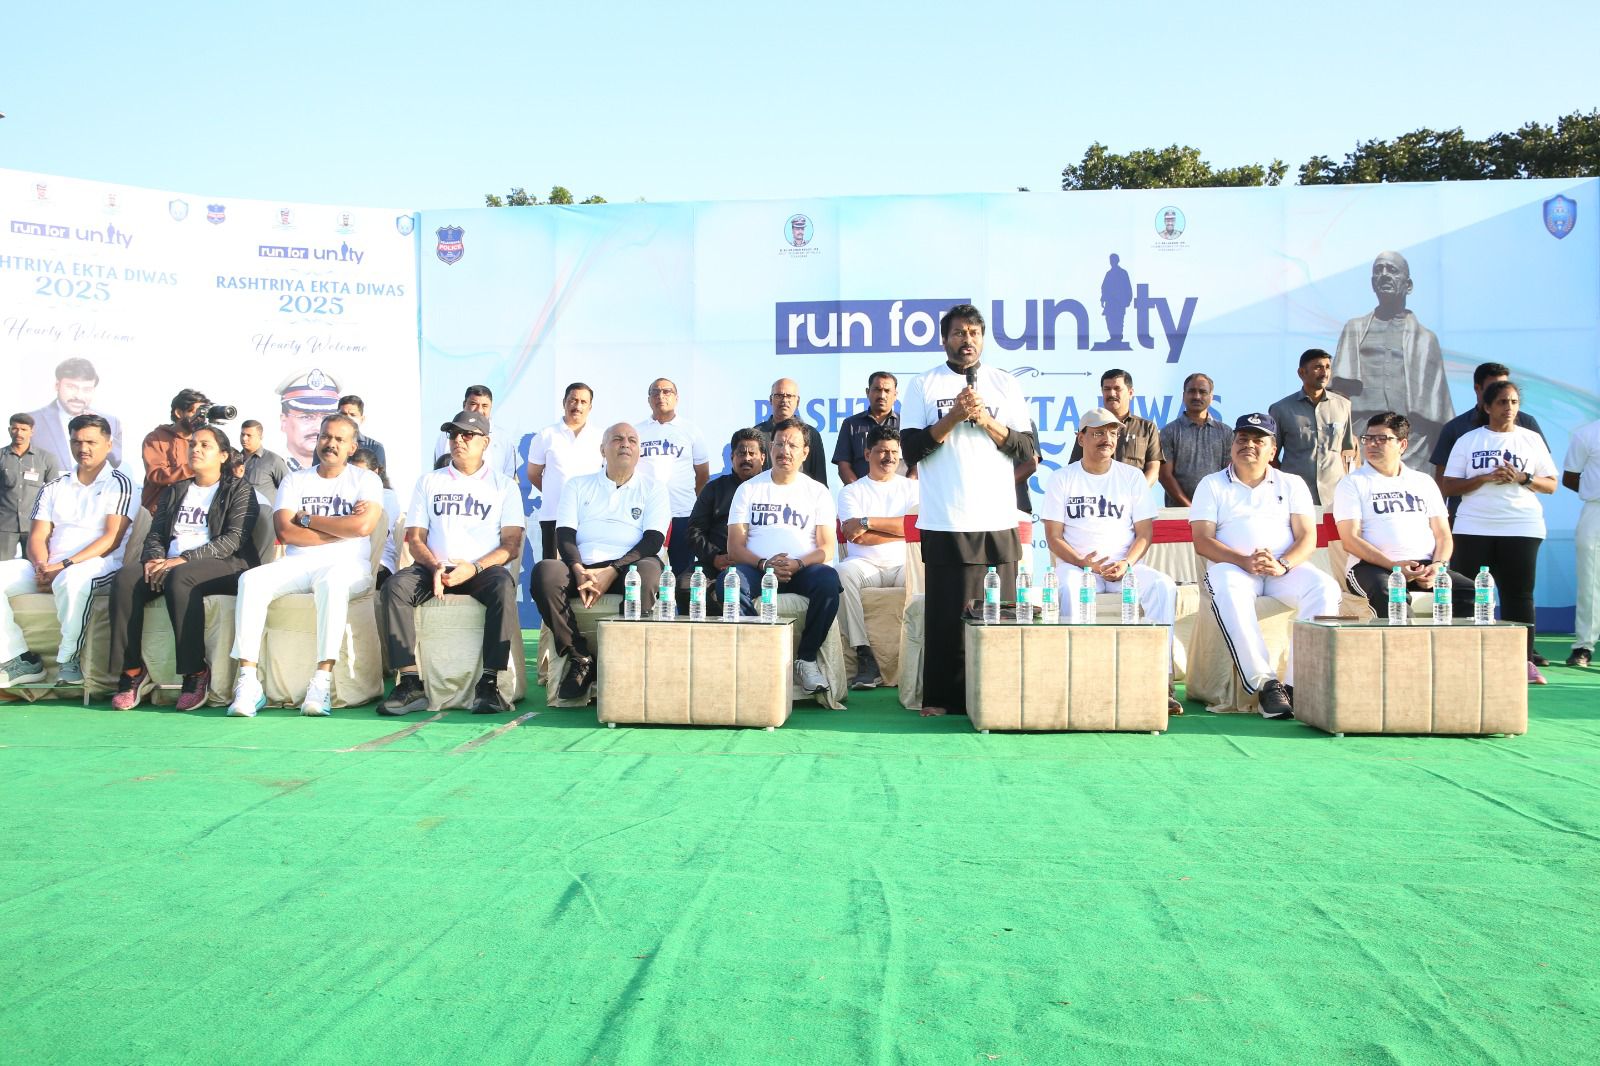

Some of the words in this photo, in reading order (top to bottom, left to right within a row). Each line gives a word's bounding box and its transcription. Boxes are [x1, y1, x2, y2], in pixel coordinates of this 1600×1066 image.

[13, 222, 42, 236] run
[45, 223, 67, 239] for
[76, 222, 133, 249] unity
[439, 243, 463, 251] POLICE
[260, 247, 285, 258] run
[286, 247, 306, 259] for
[313, 241, 364, 265] unity
[72, 262, 118, 280] EKTA
[124, 267, 178, 286] DIWAS
[216, 275, 305, 292] RASHTRIYA
[311, 280, 351, 295] EKTA
[356, 283, 405, 297] DIWAS
[35, 276, 111, 302] 2025
[278, 294, 344, 316] 2025
[788, 312, 873, 348] run
[991, 253, 1199, 364] unity
[3, 317, 64, 342] Hearty
[68, 321, 136, 343] Welcome
[251, 333, 302, 357] Hearty
[306, 335, 368, 354] Welcome
[937, 399, 955, 407] run
[433, 493, 492, 521] unity
[434, 494, 449, 502] run
[752, 503, 768, 511] run
[1066, 494, 1125, 519] unity
[750, 503, 810, 530] unity
